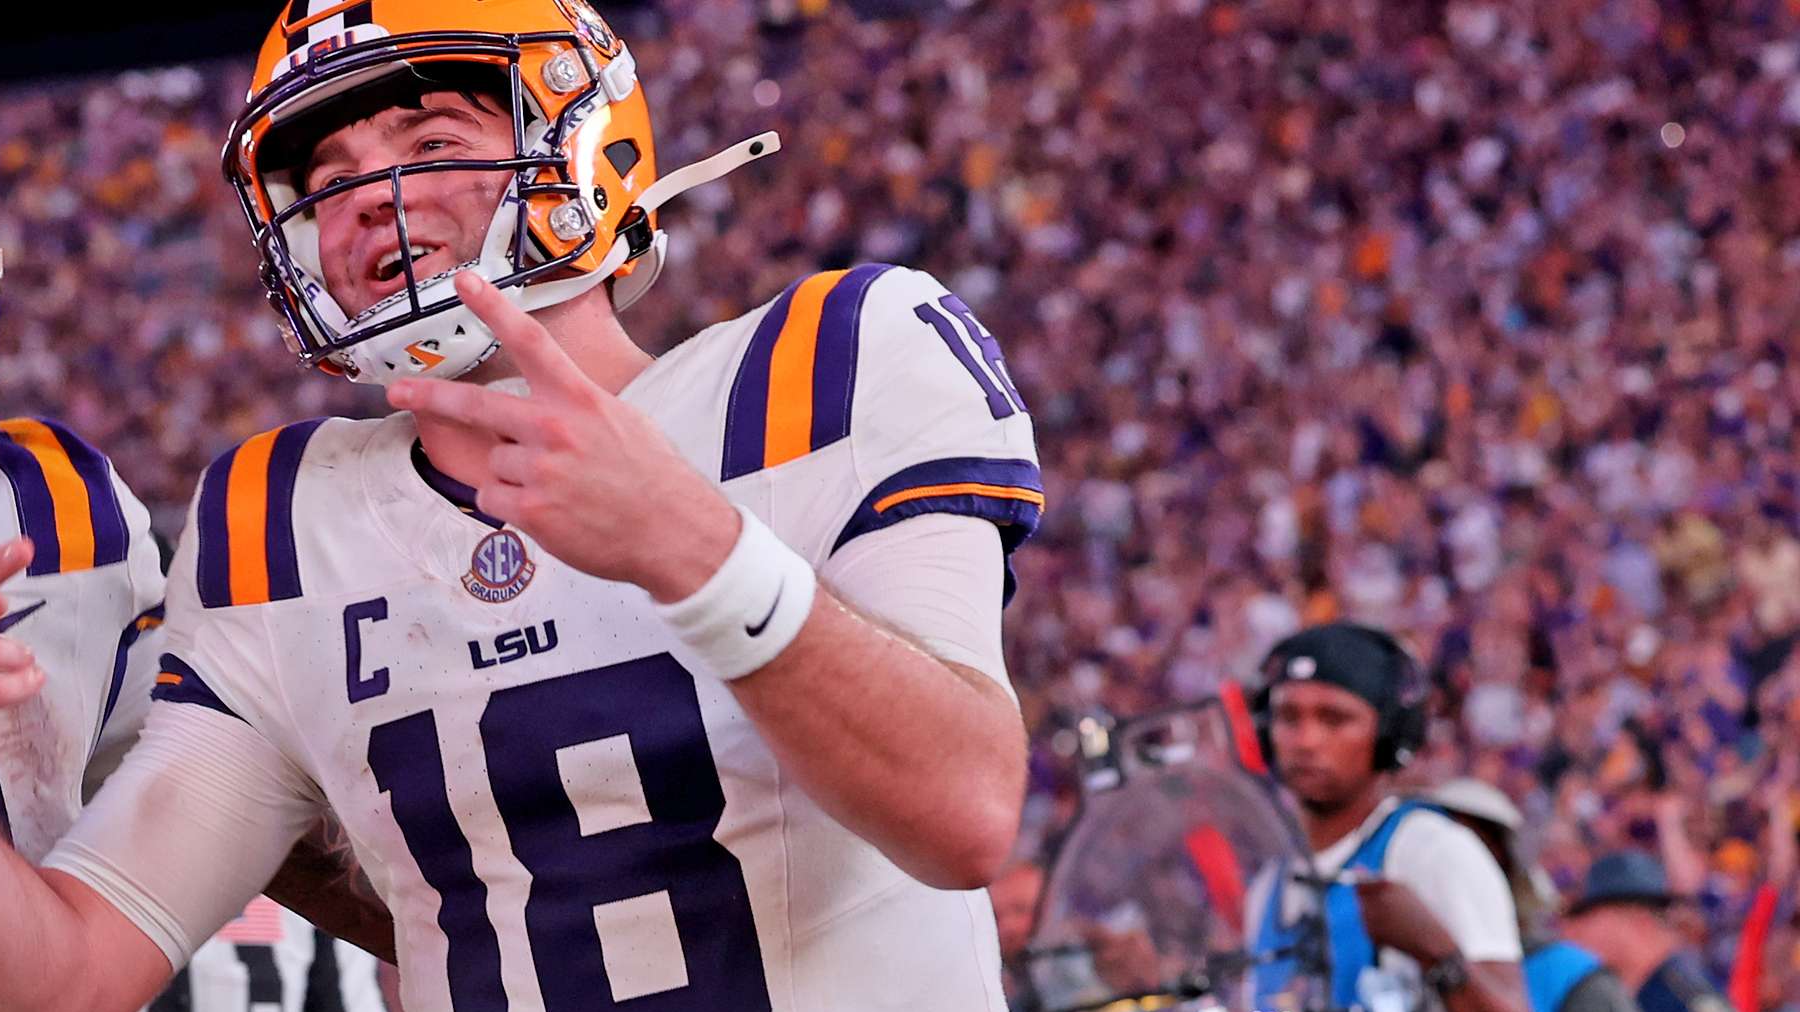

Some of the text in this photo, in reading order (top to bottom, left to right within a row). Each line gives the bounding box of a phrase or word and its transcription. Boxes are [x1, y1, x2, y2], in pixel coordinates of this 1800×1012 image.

[913, 293, 1029, 421] 18
[477, 534, 523, 584] SEC
[343, 596, 390, 704] C
[467, 619, 559, 670] LSU
